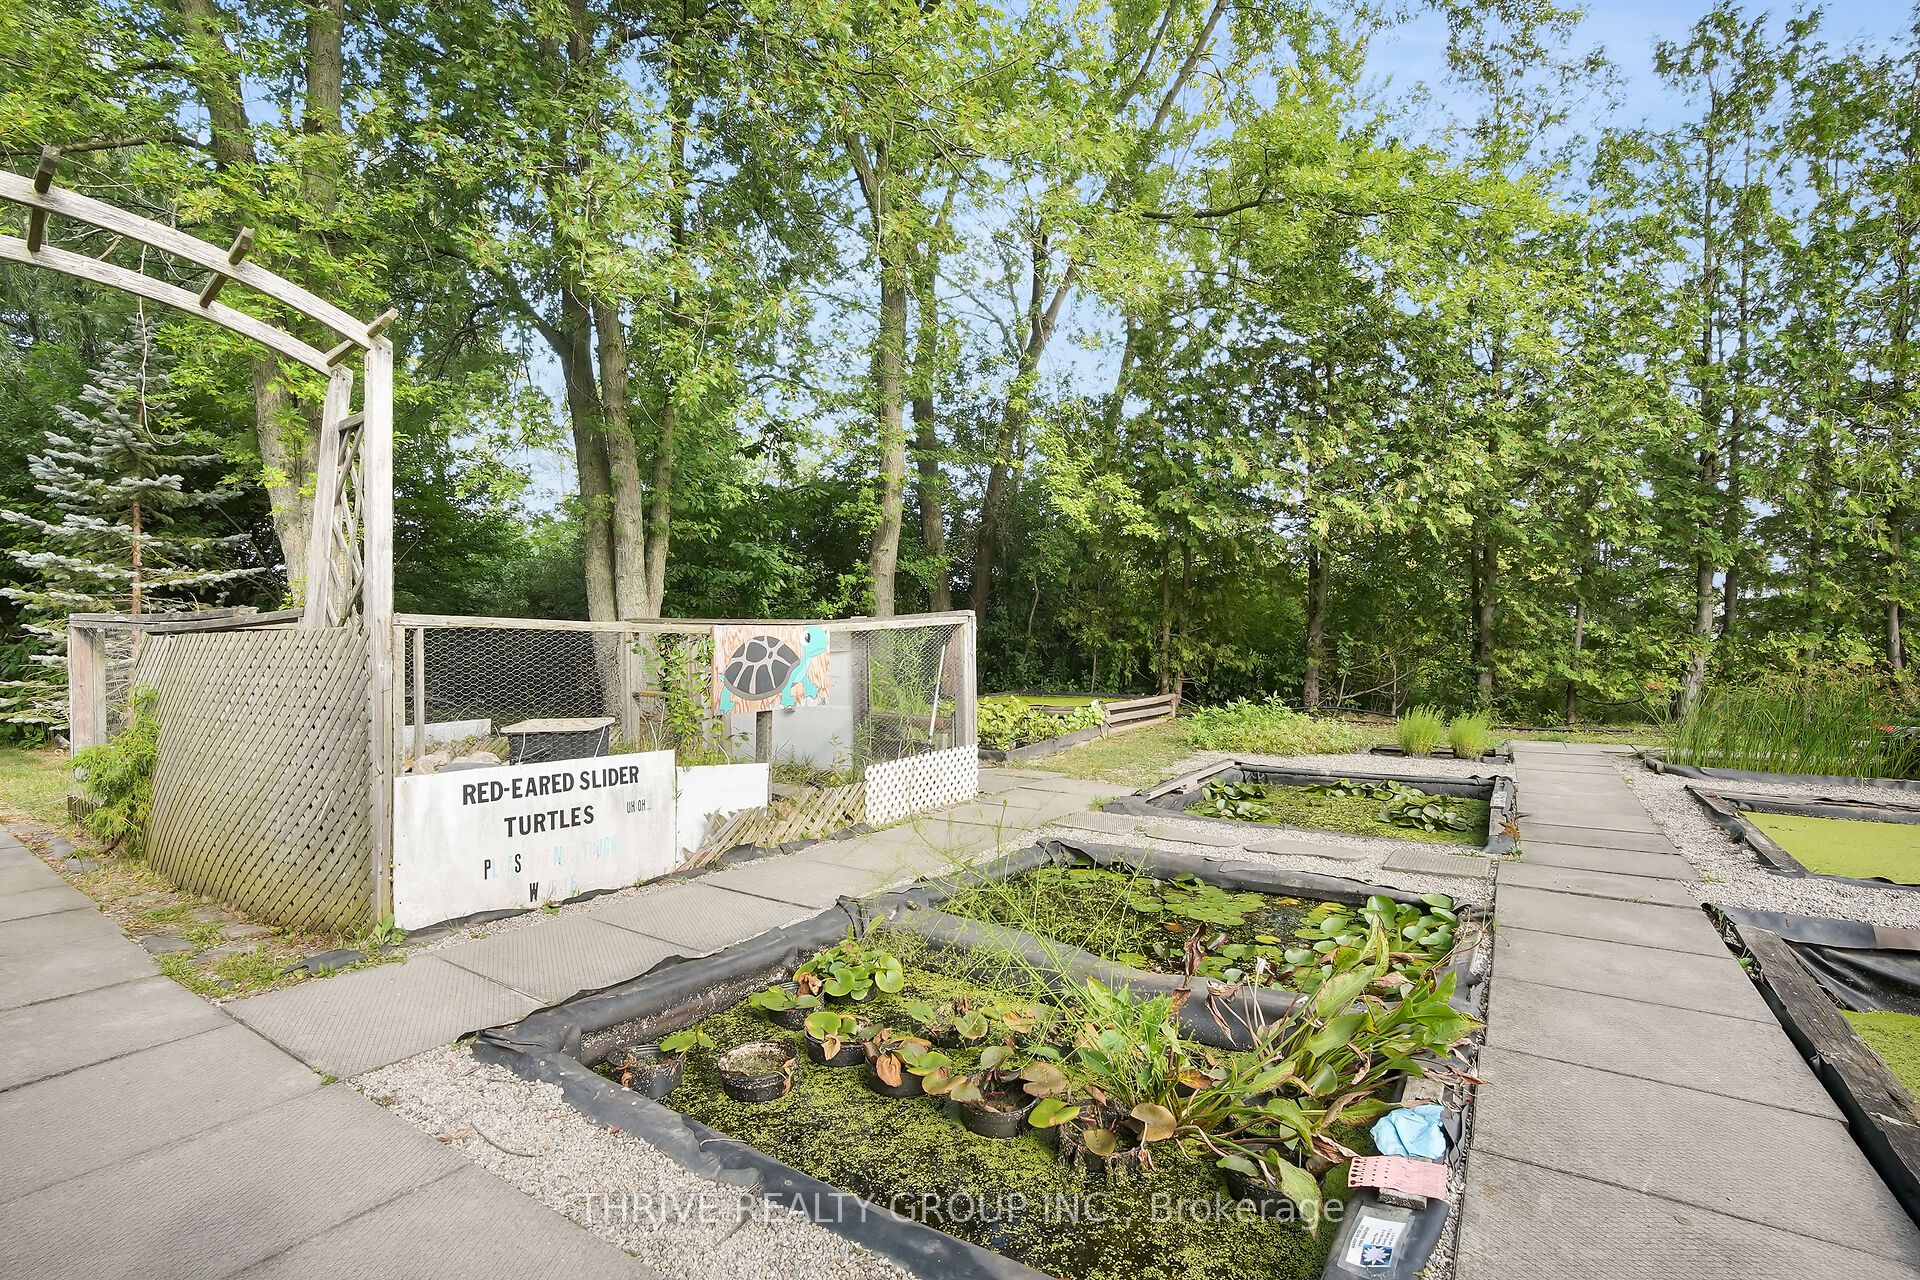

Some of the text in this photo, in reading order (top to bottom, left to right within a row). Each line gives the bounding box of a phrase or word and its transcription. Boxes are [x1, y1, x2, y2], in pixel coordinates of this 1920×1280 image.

[462, 765, 640, 806] RED-EARED SLIDER
[504, 805, 595, 838] TURTLES
